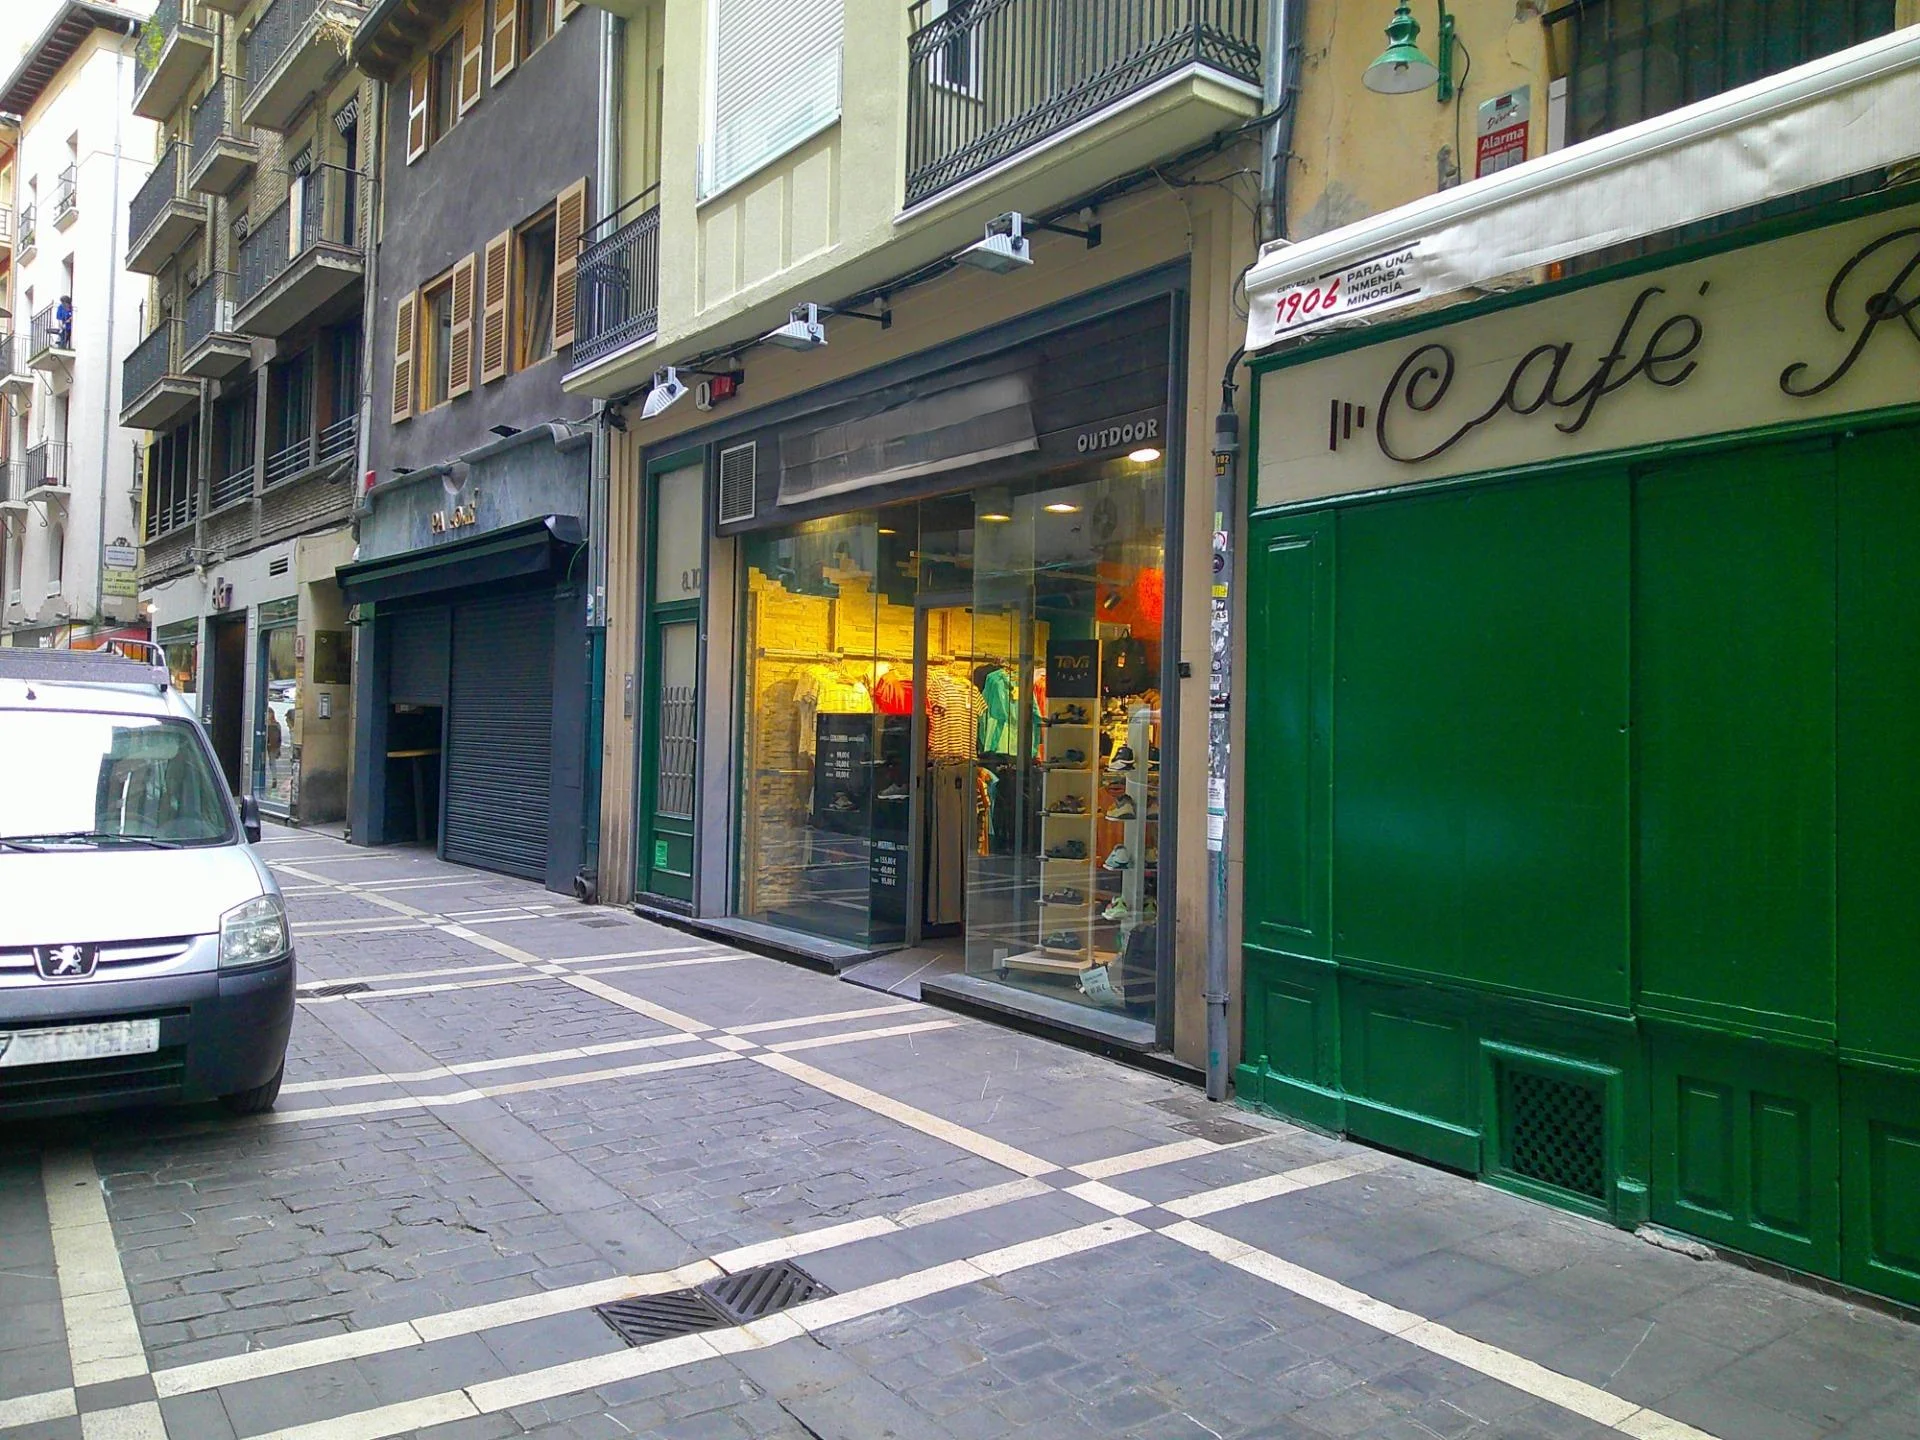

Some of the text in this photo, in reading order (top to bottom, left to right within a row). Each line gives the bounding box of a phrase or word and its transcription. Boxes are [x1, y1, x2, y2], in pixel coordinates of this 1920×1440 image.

[1481, 128, 1525, 151] Alarma
[1347, 251, 1414, 282] PARA UNA
[1347, 267, 1405, 295] INMENSA
[1277, 276, 1316, 293] CERVEZAS
[1346, 280, 1403, 307] MINORÍA
[1274, 277, 1341, 323] 1906
[1376, 281, 1710, 463] Café
[1077, 418, 1158, 453] OUTDOOR
